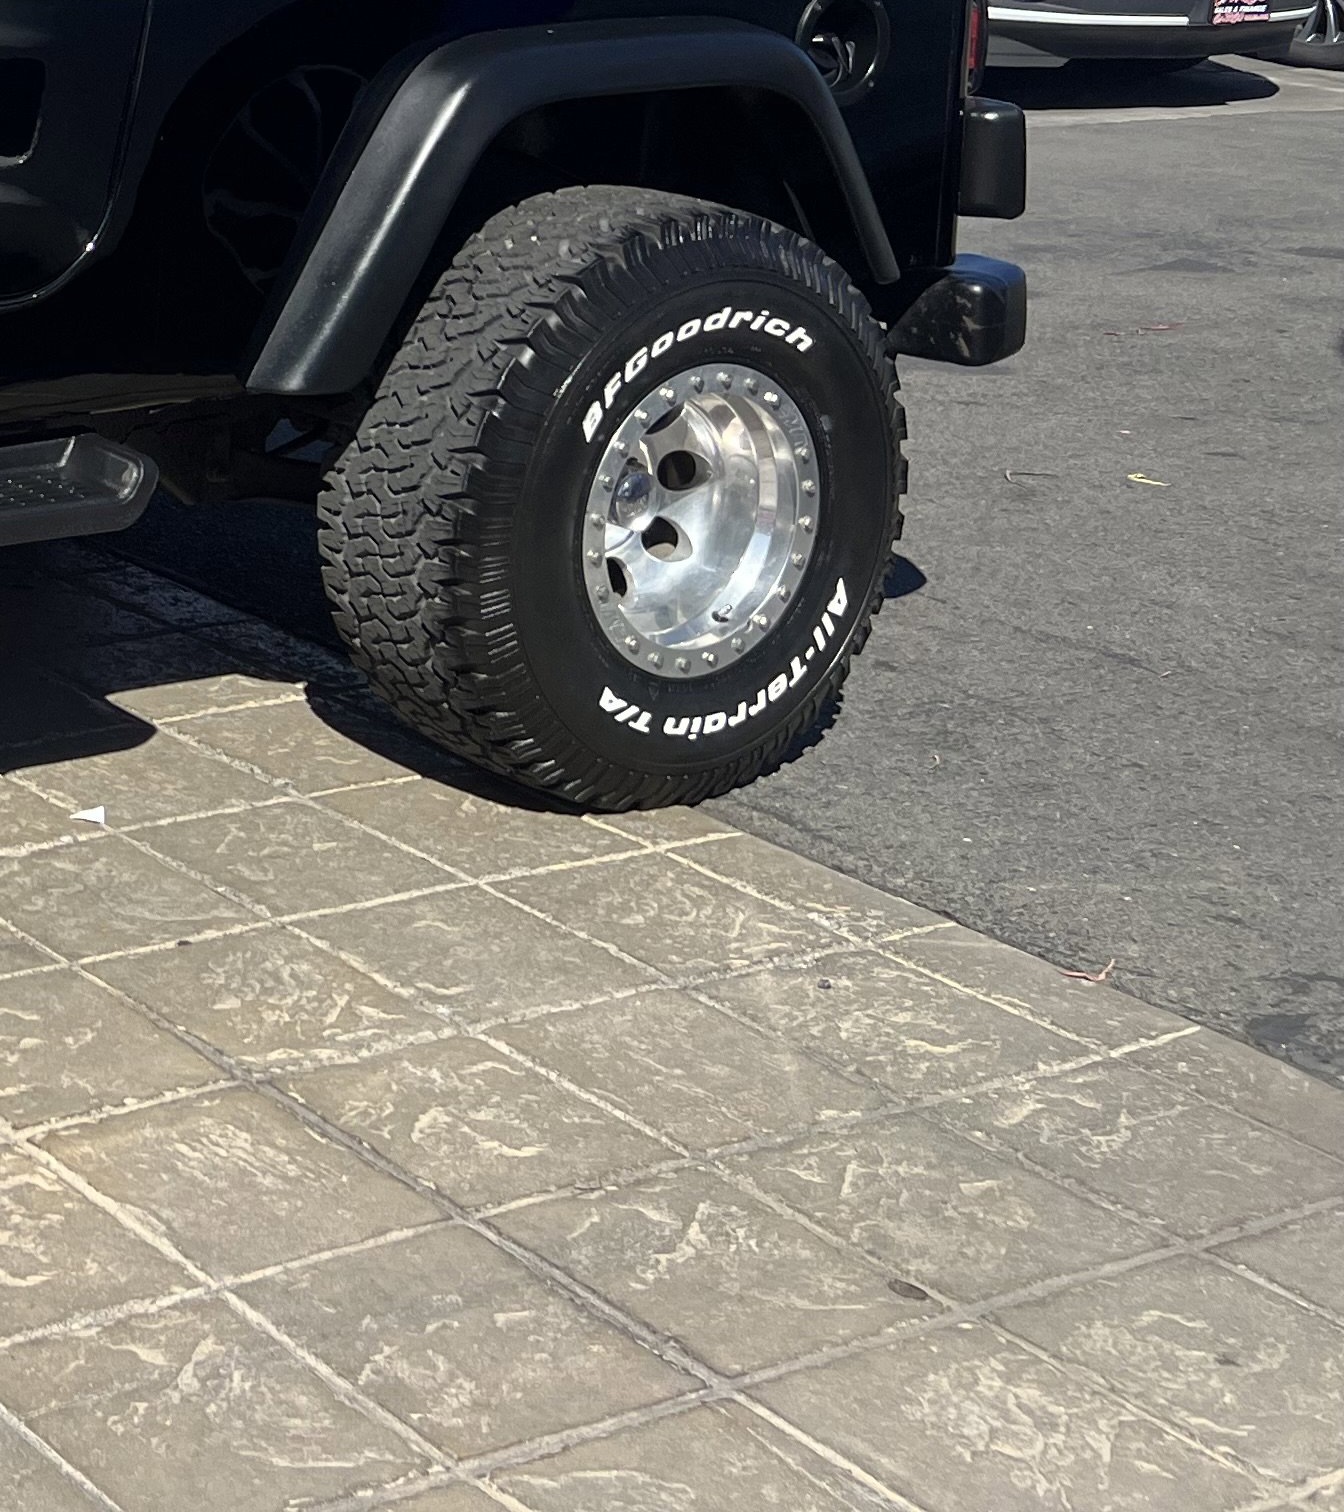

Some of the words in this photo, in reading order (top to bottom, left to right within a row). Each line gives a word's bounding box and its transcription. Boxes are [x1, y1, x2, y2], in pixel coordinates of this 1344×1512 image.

[582, 307, 814, 444] BFGoodrich
[598, 686, 653, 736] T/A
[663, 576, 849, 741] All-Terrain
